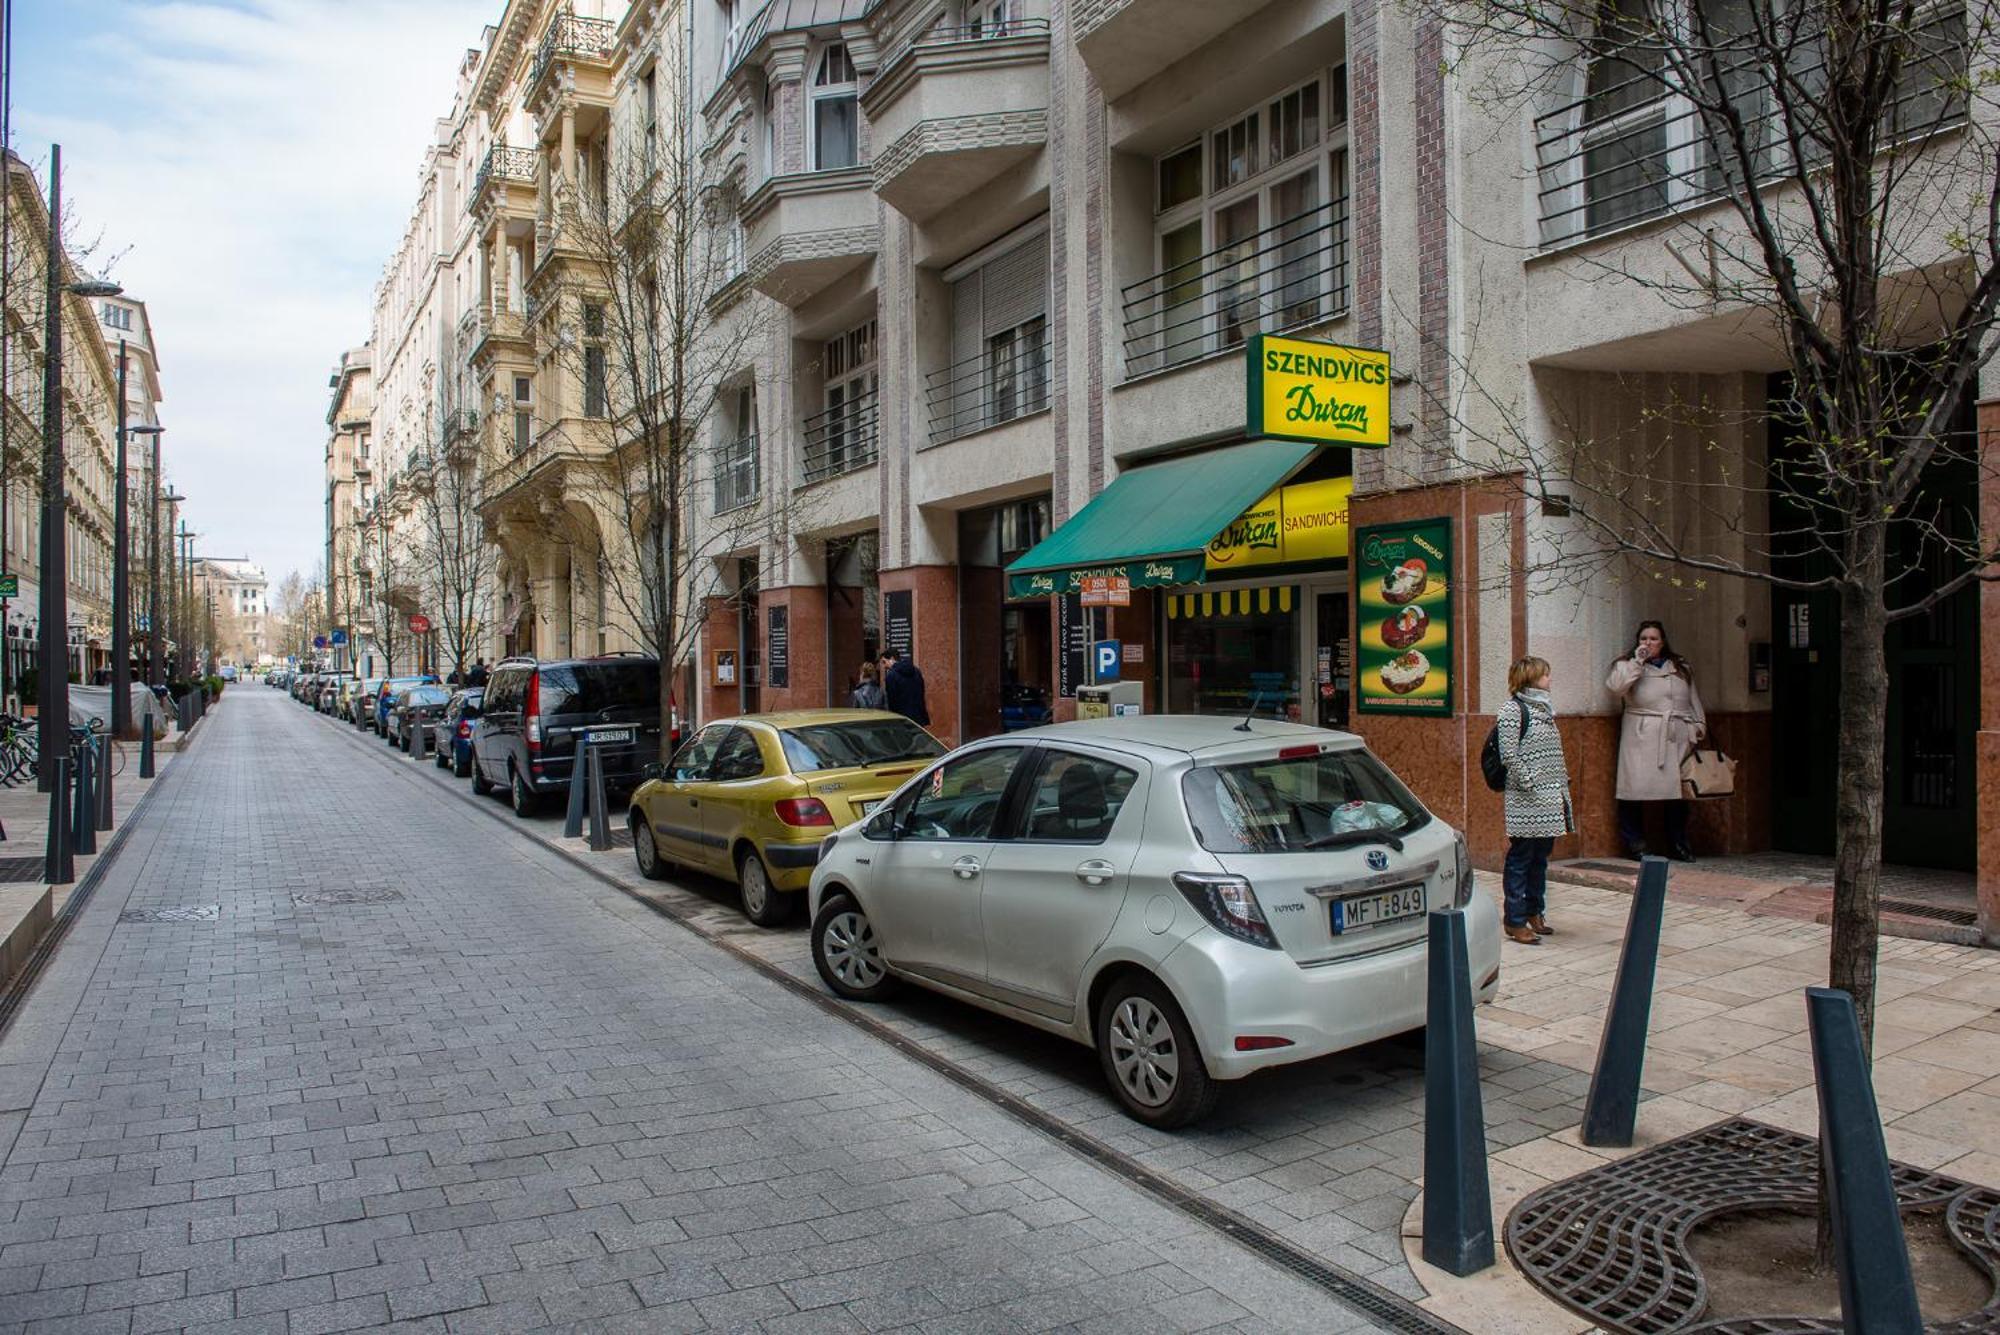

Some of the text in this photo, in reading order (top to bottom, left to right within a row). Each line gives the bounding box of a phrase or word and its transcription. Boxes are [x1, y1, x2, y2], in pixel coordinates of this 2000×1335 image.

[1266, 350, 1386, 385] SZENDVICS
[1286, 384, 1369, 434] Duran
[1099, 648, 1117, 673] P
